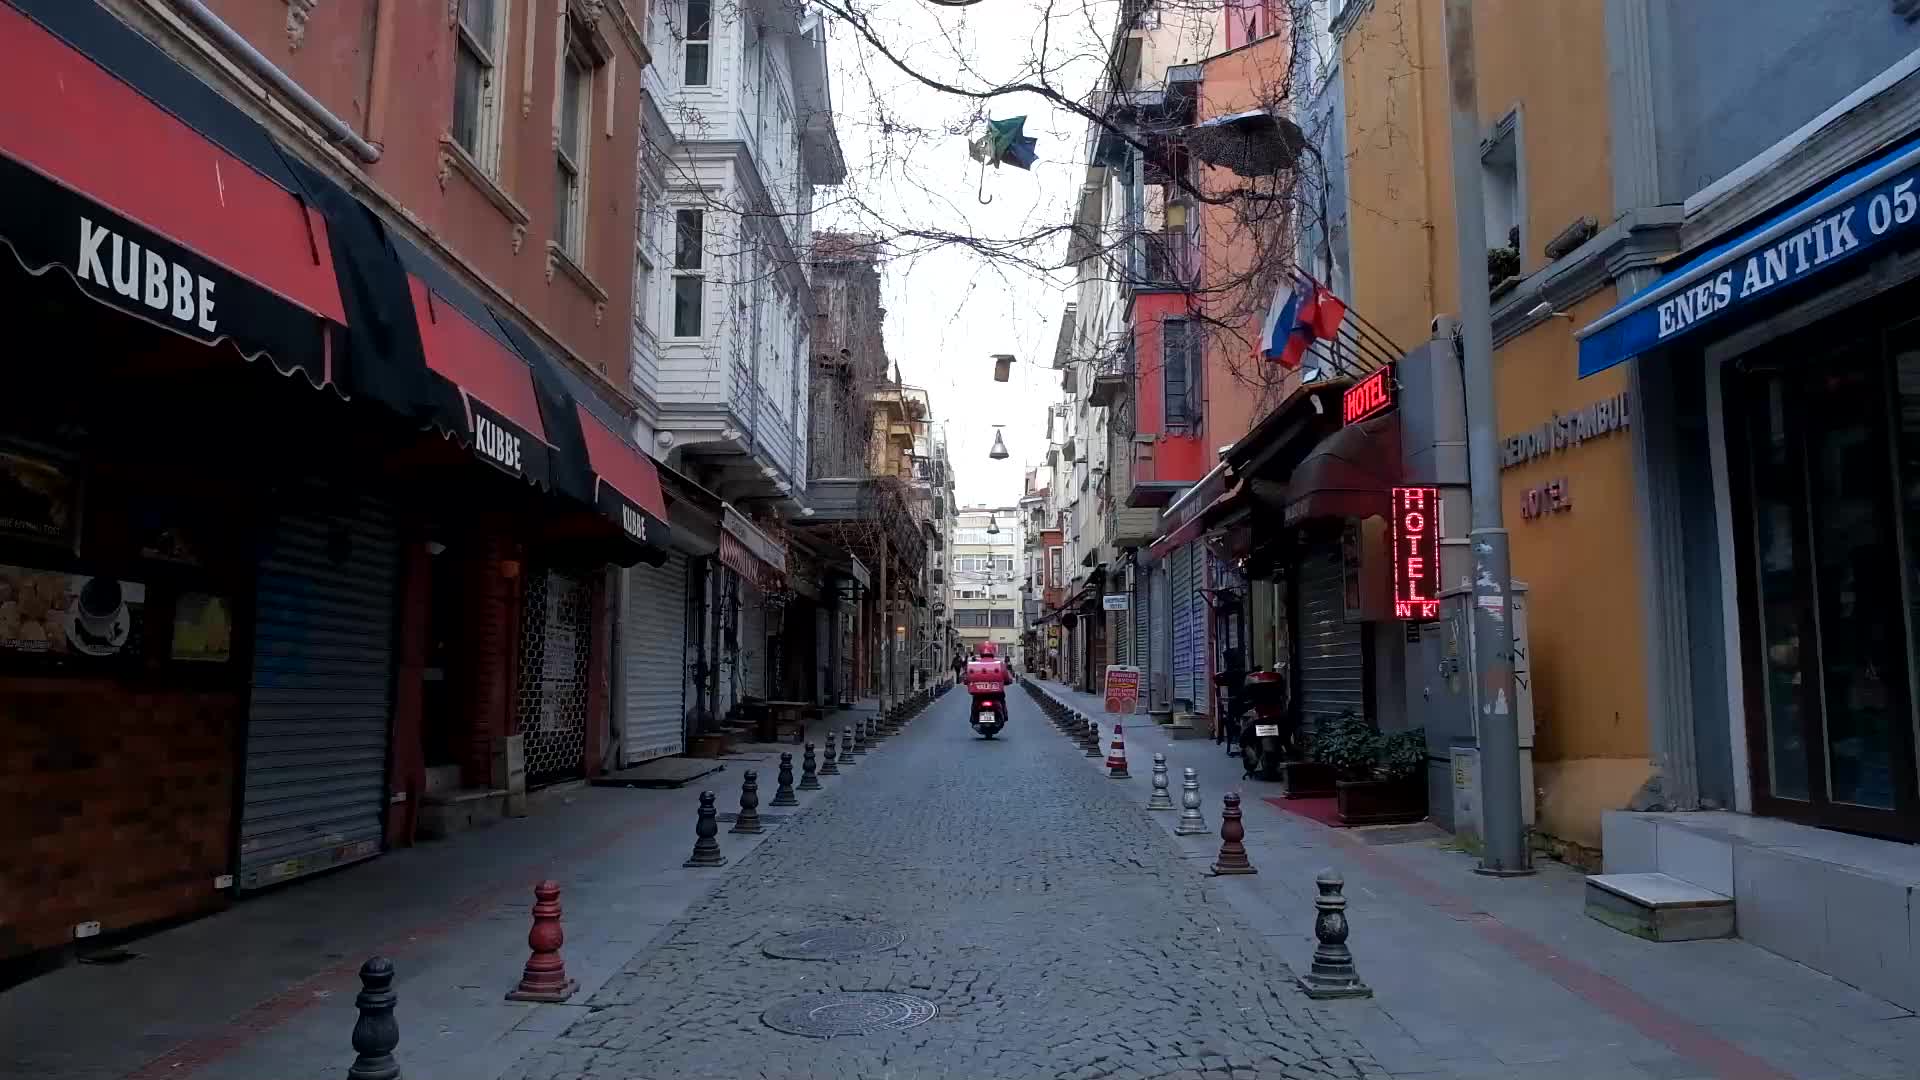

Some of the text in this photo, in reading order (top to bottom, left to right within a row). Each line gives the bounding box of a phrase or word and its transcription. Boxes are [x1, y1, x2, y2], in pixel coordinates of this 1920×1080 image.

[76, 215, 218, 333] KUBBE
[1657, 177, 1920, 339] ENES ANTİK 05
[1347, 374, 1387, 421] HOTEL
[475, 413, 522, 471] KUBBE
[622, 502, 648, 541] KUBBE
[1404, 488, 1425, 601] HOTEL
